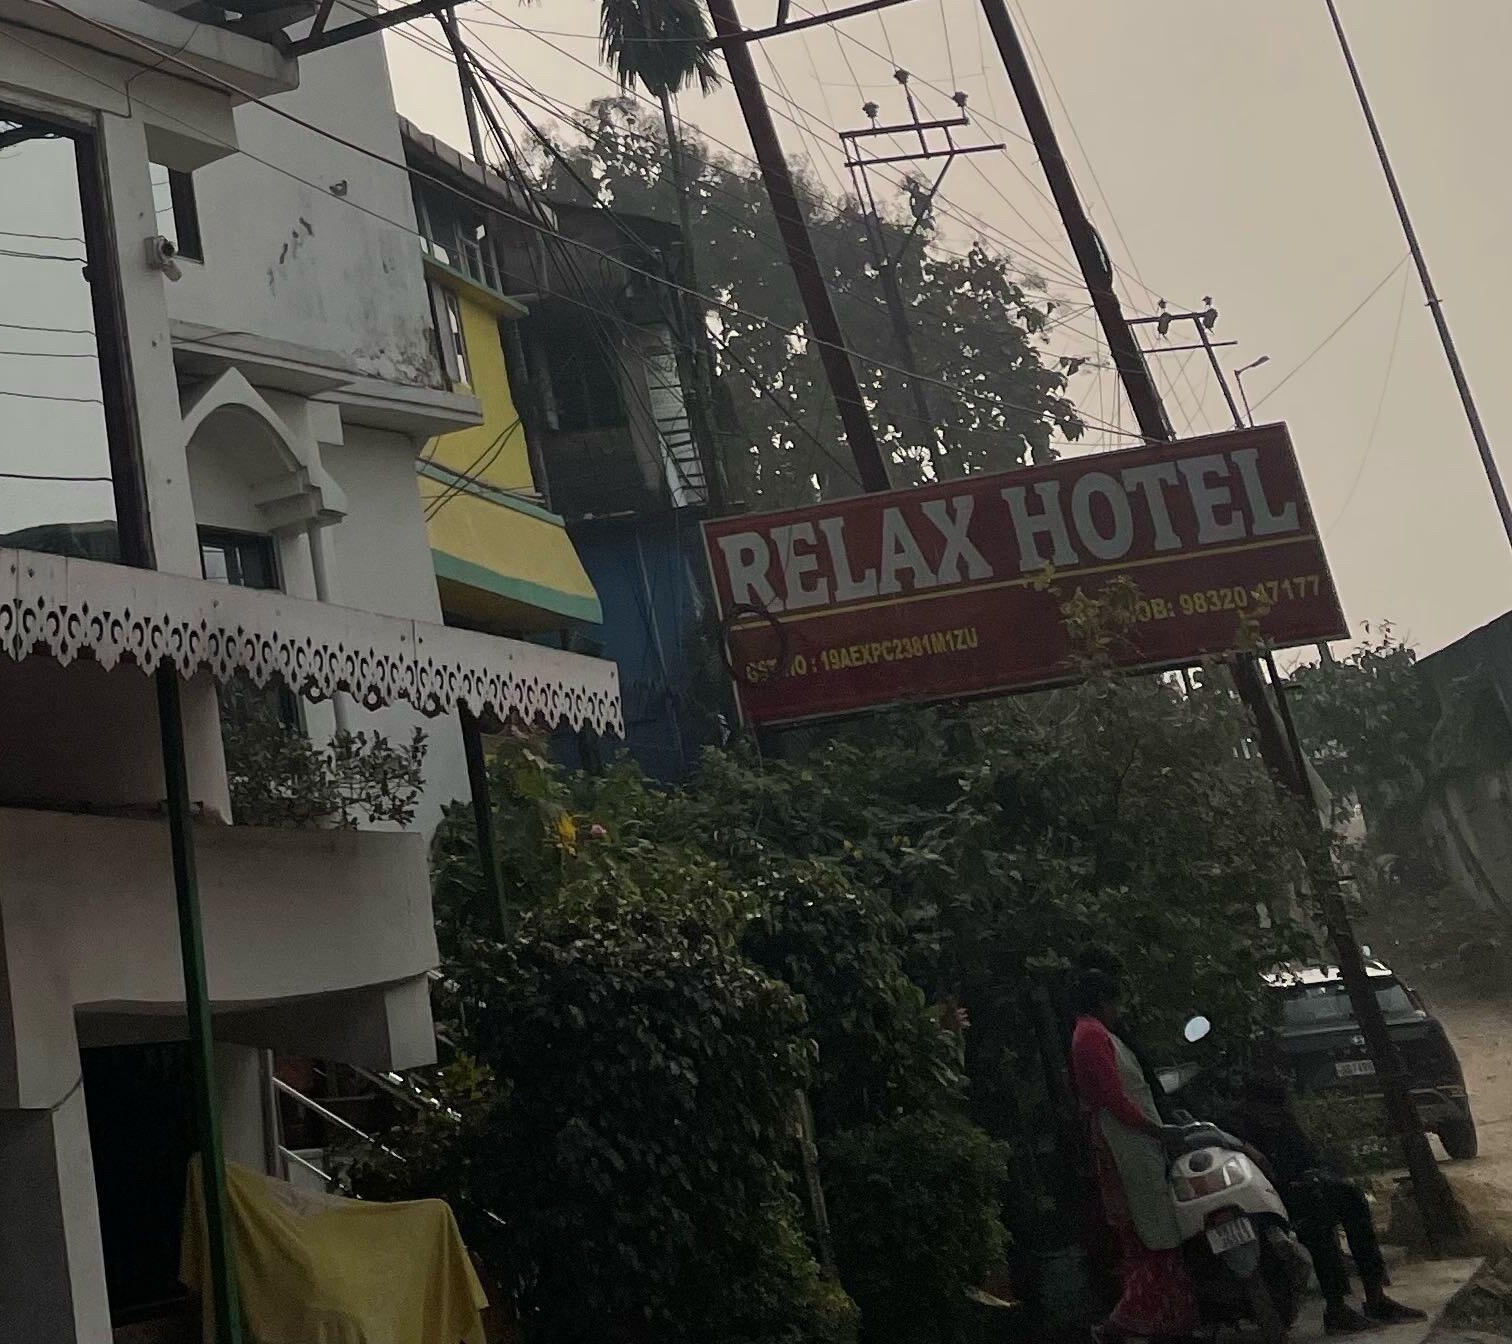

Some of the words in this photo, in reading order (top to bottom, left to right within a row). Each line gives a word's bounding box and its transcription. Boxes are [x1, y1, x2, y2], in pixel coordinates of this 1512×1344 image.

[718, 495, 994, 614] RELAX
[1000, 448, 1299, 572] HOTEL
[1120, 597, 1176, 624] OB:
[1179, 587, 1248, 615] 98320
